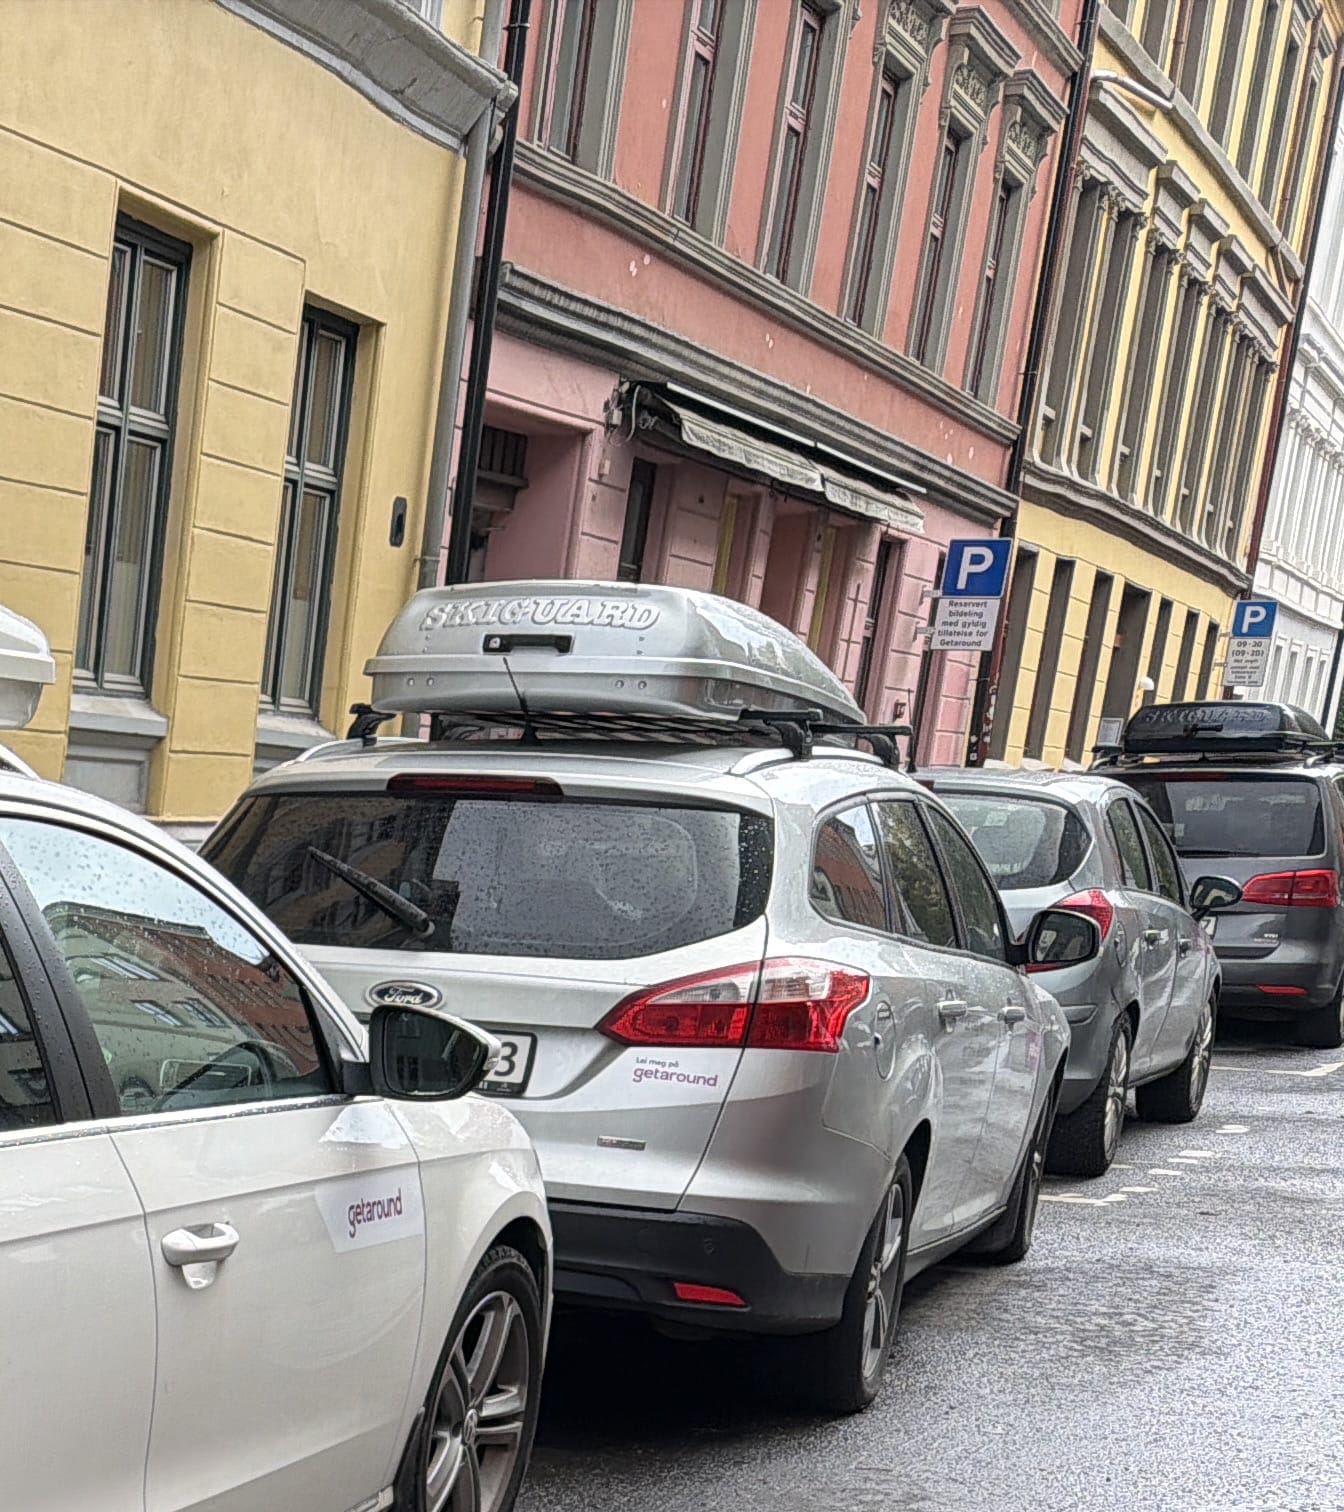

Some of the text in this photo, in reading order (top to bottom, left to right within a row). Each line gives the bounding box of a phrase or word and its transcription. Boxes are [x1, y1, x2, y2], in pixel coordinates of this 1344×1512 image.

[956, 546, 994, 590] P
[419, 597, 661, 630] SKIGUARD
[948, 600, 988, 608] Reservert
[941, 619, 959, 627] med
[1241, 605, 1267, 634] P
[939, 639, 982, 647] Getaround
[383, 987, 424, 1004] Ford
[632, 1067, 719, 1087] getaround
[347, 1187, 403, 1239] getaround
